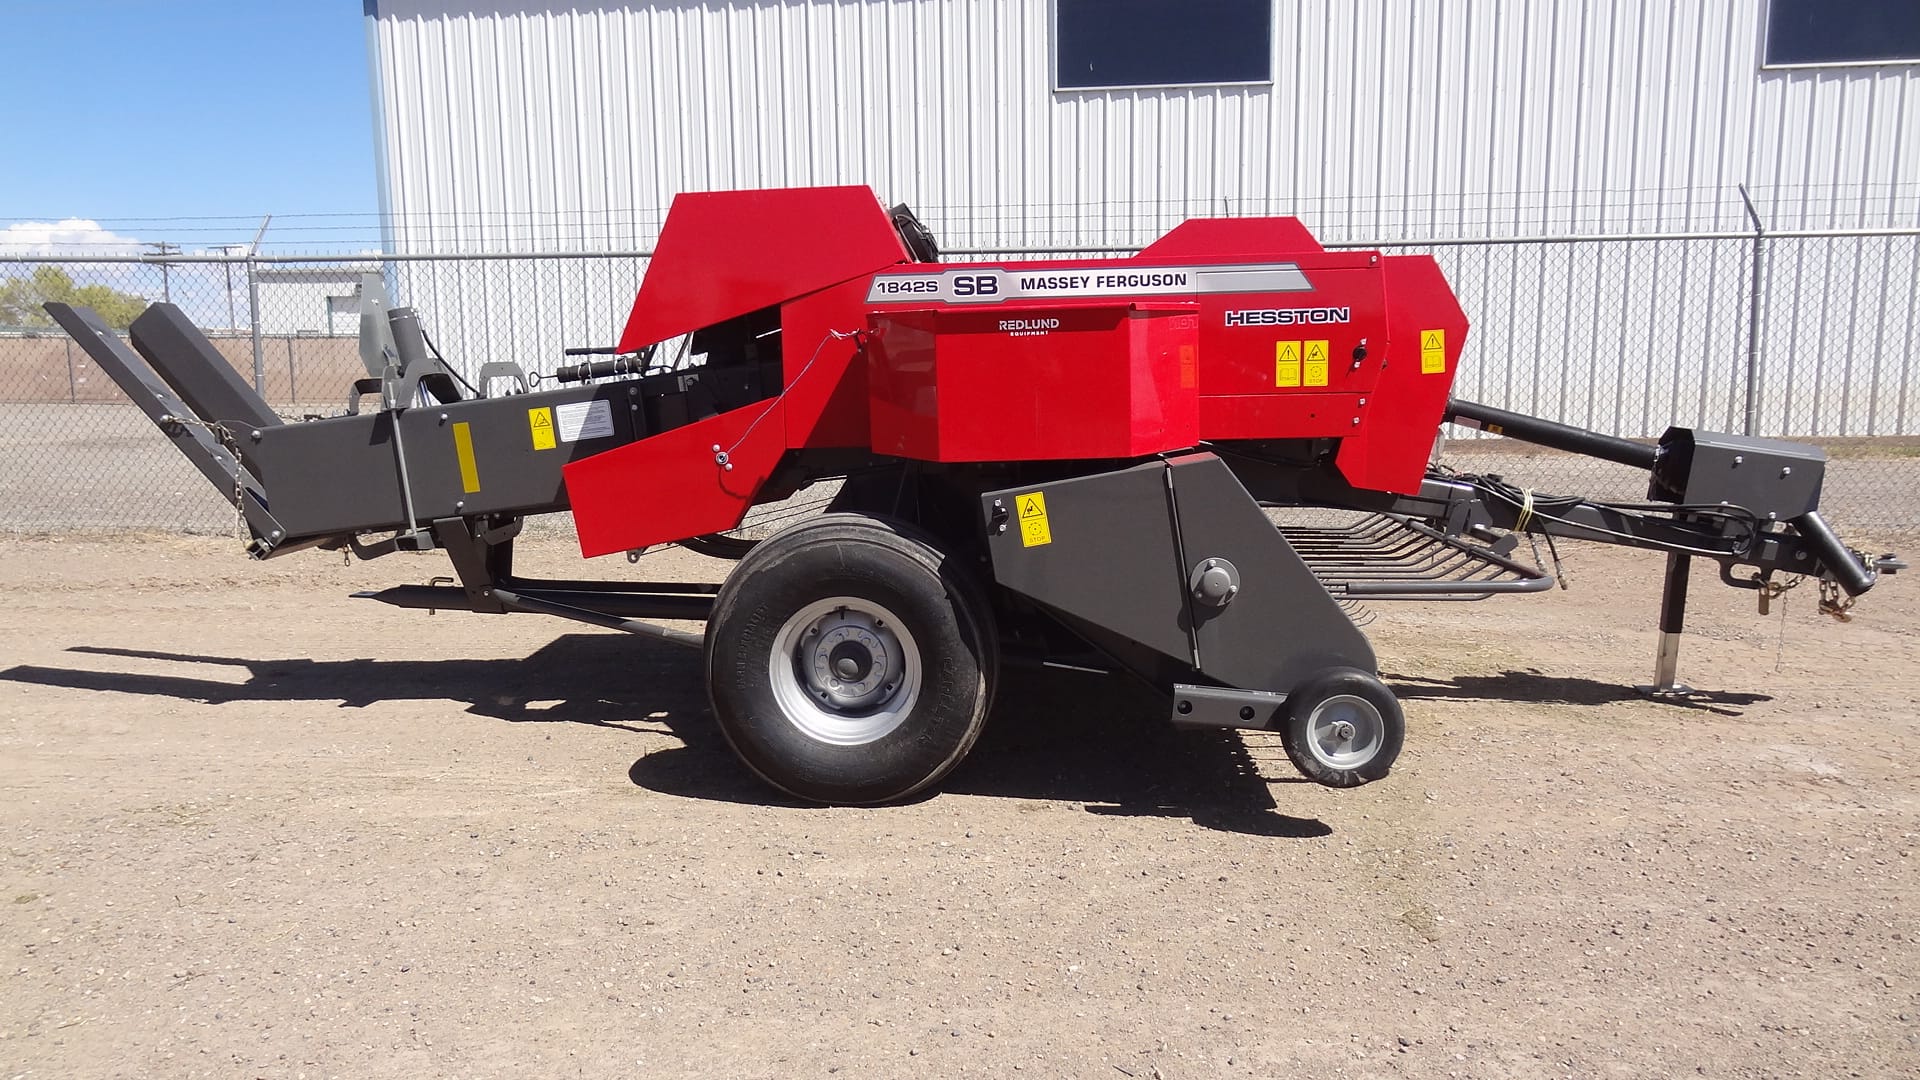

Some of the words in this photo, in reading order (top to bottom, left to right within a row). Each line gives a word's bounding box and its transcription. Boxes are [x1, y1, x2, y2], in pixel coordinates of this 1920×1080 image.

[876, 280, 939, 294] 1842S
[953, 275, 999, 296] SB
[1020, 276, 1090, 290] MASSEY
[1096, 273, 1188, 288] FERGUSON
[999, 318, 1060, 331] REDLUND
[1225, 307, 1350, 326] HESSTON
[1029, 535, 1046, 543] STOP
